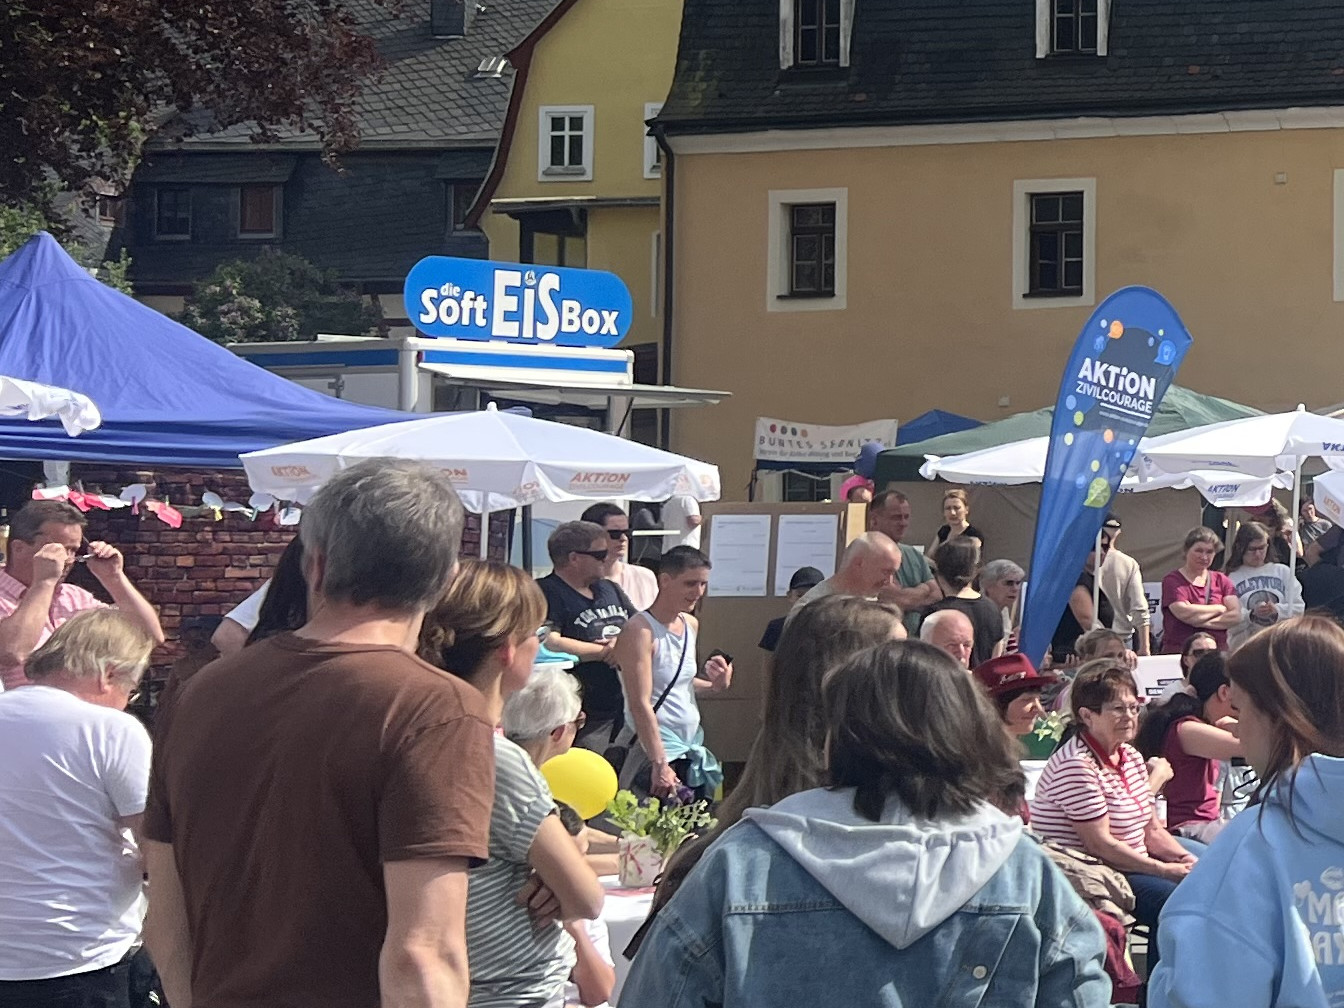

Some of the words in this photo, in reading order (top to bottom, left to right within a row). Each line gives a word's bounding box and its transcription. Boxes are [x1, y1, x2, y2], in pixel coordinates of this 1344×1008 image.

[440, 282, 461, 298] die
[419, 288, 488, 328] Soft
[1075, 380, 1154, 414] ZIVILCOURAGE
